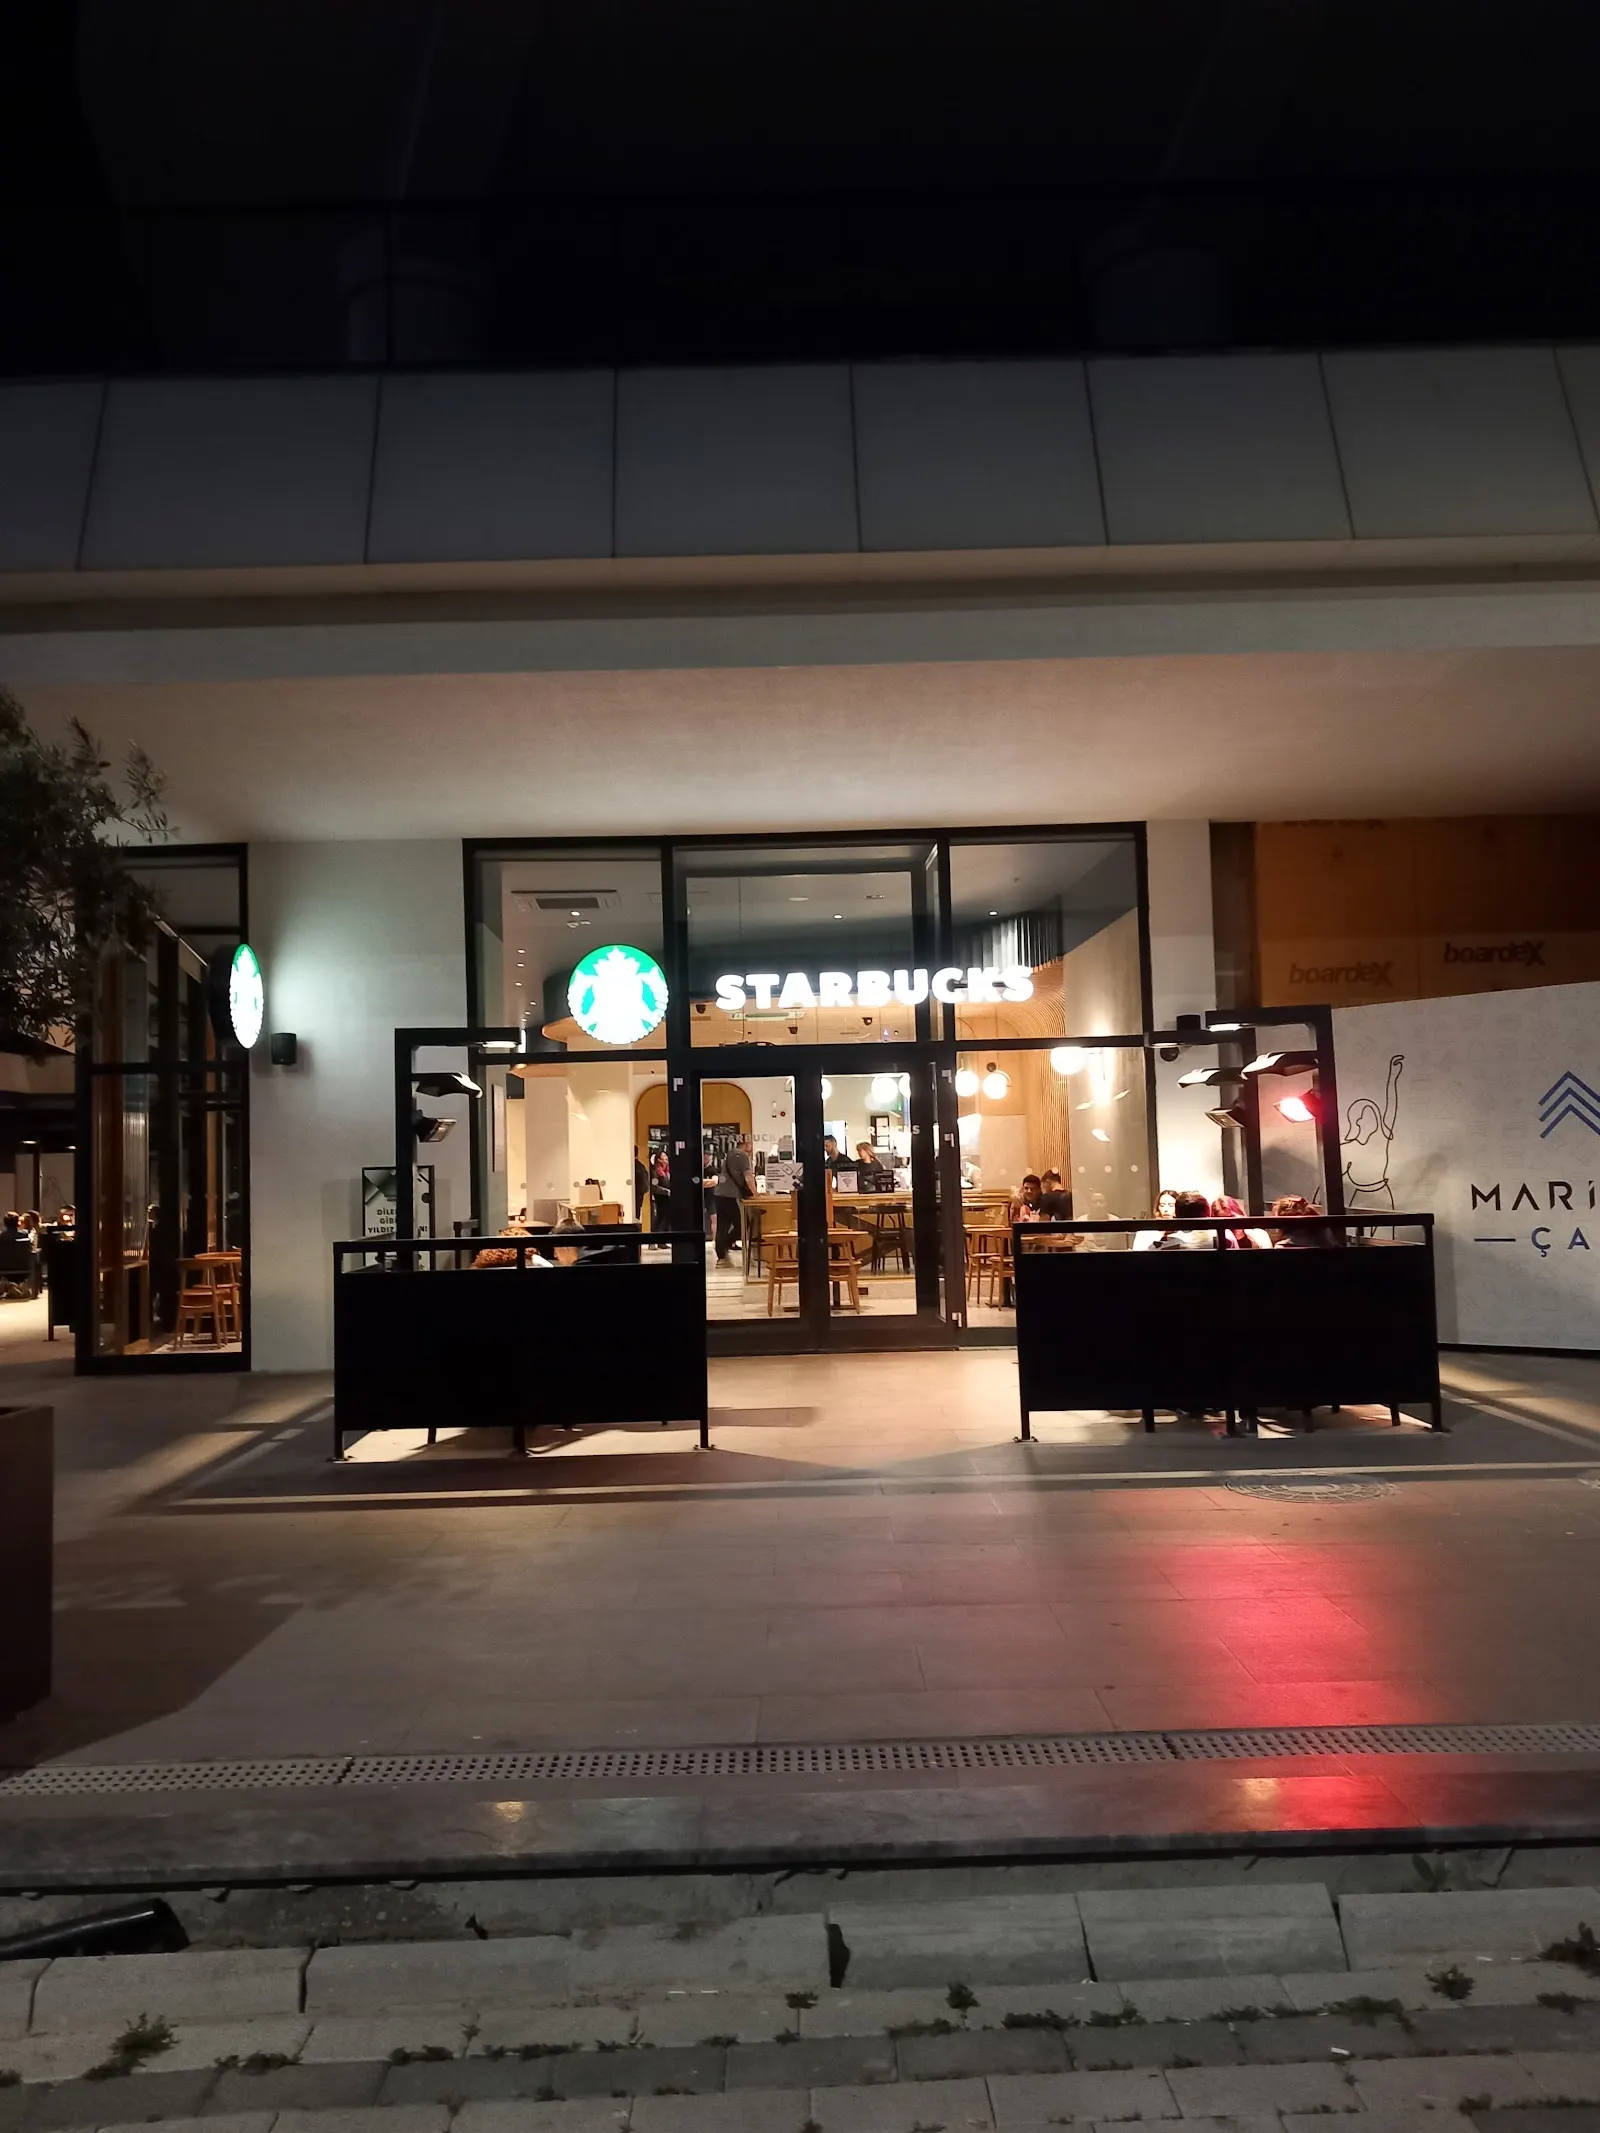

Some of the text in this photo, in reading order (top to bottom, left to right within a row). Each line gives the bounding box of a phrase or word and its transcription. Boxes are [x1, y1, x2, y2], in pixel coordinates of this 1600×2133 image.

[714, 965, 1035, 1011] STARBUCKS
[1471, 1180, 1596, 1211] MARİ
[1531, 1227, 1591, 1258] ÇA
